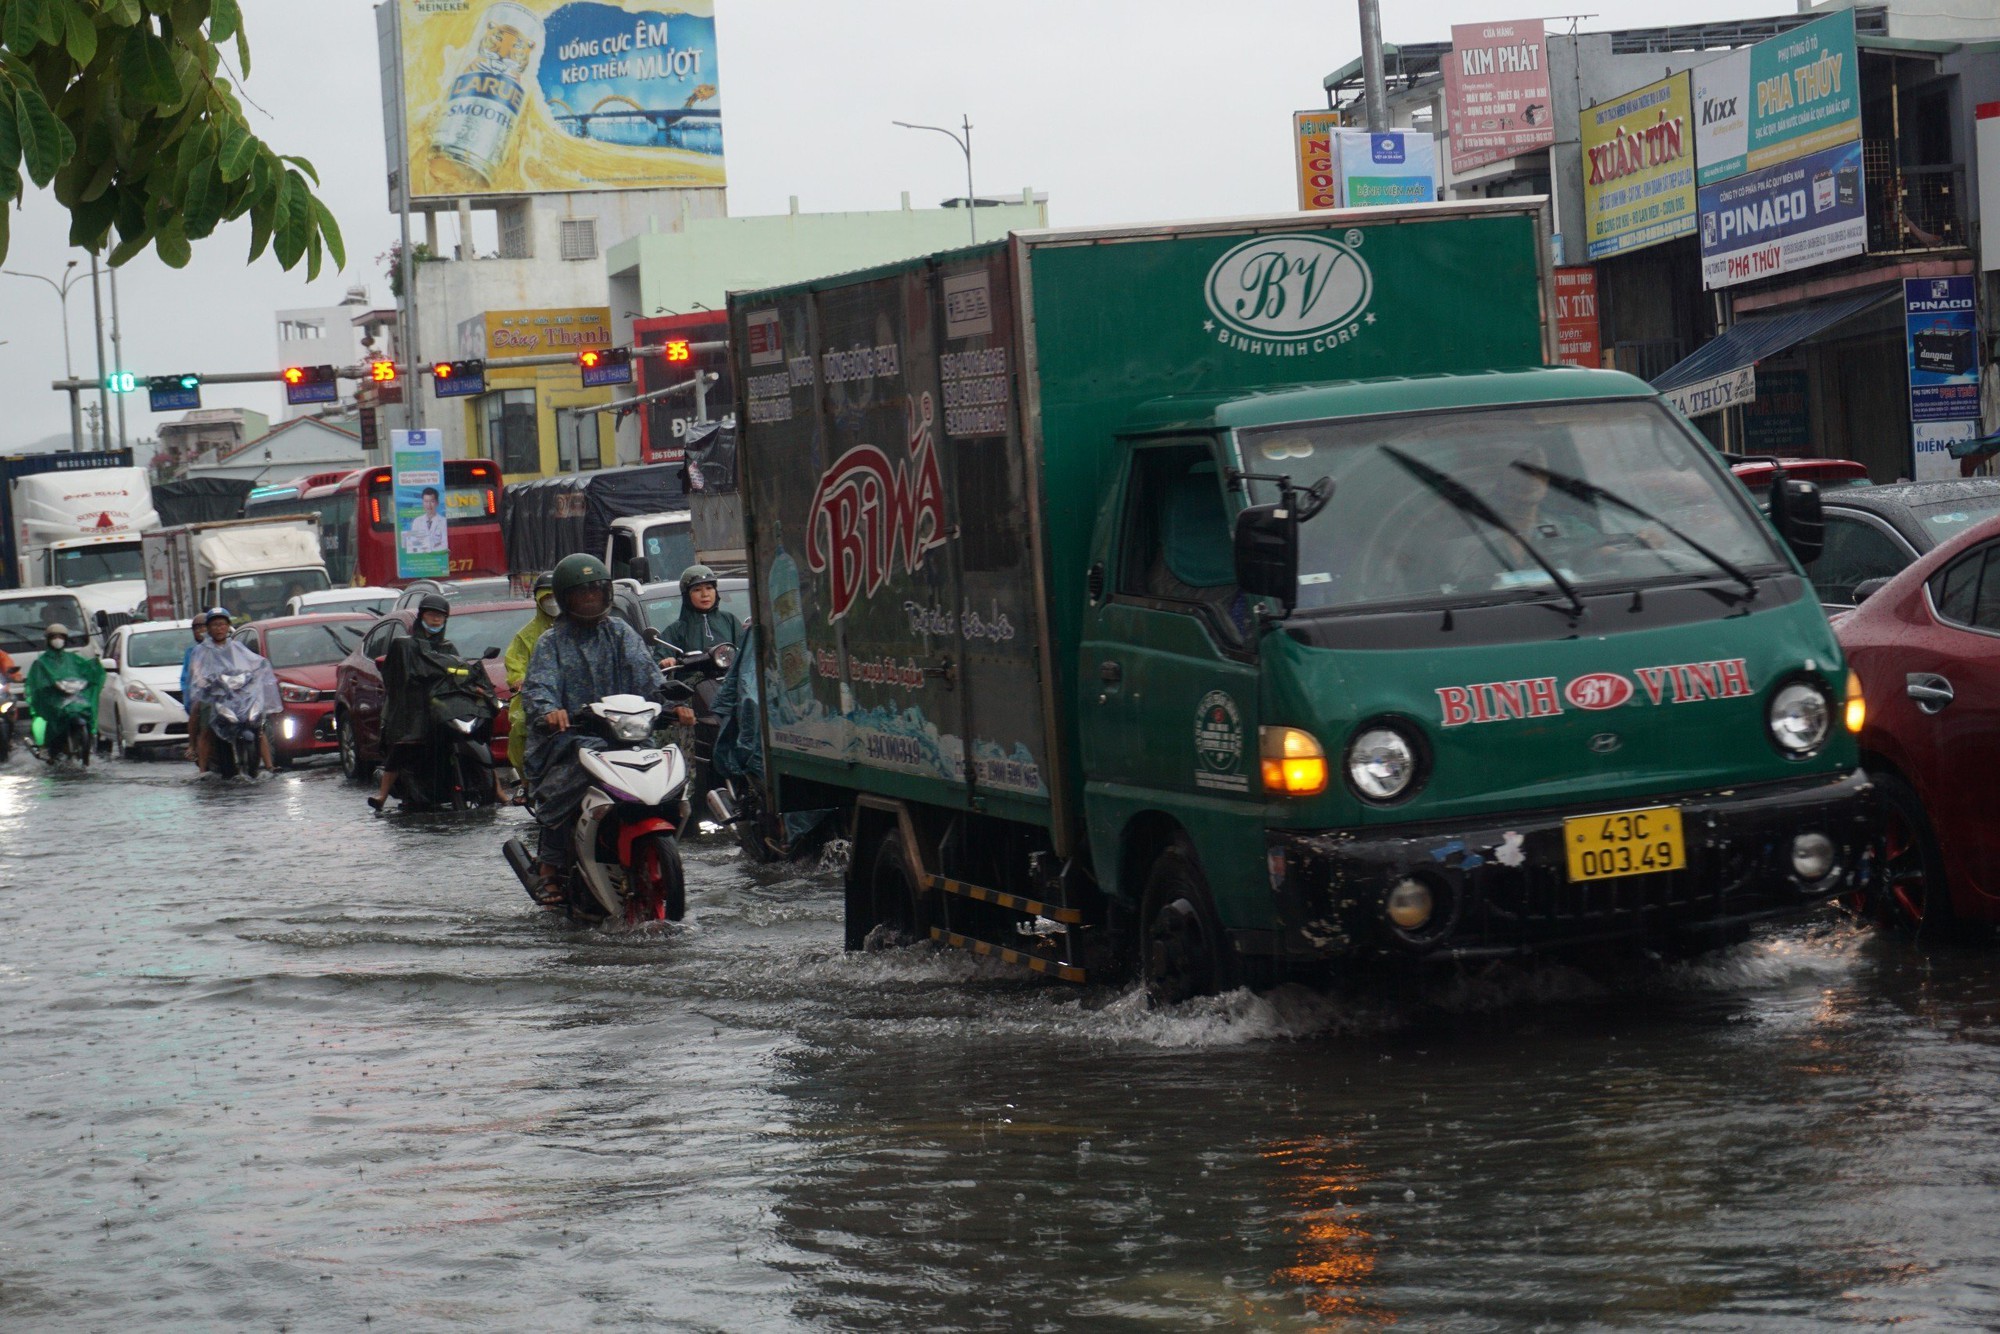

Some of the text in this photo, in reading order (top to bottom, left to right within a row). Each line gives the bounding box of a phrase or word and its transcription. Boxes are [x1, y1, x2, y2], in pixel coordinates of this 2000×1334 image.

[418, 2, 470, 12] HEINEKEN
[559, 20, 669, 61] UỐNG CỰC ÊM
[1496, 26, 1514, 37] HÀNG
[1810, 33, 1818, 50] TÔ
[561, 48, 703, 85] KÈO THÊM MƯỢT
[1462, 39, 1539, 76] KIM PHÁT
[452, 76, 525, 109] LARUE
[1757, 49, 1842, 119] PHA THÚY
[448, 104, 511, 129] SMOOTH
[1702, 96, 1738, 126] Kixx
[1589, 108, 1684, 186] XUÂN TÍN
[1357, 184, 1380, 197] BỆNH
[1384, 184, 1404, 196] VIỆN
[1719, 190, 1733, 203] CÔNG
[1733, 189, 1739, 200] TY
[1757, 180, 1766, 193] PIN
[1772, 176, 1782, 190] QUY
[1794, 169, 1805, 182] NAM
[1720, 189, 1807, 240] PINACO
[1728, 254, 1750, 279] PHA
[1752, 244, 1781, 274] THÚY
[1577, 272, 1593, 285] THÉP
[1572, 290, 1595, 318] TÍN
[1909, 299, 1972, 311] PINACO
[544, 326, 611, 348] Thạnh
[1218, 322, 1360, 357] BINHVINH CORP
[1559, 328, 1582, 341] uyên:
[667, 341, 689, 361] 35
[373, 361, 395, 381] 35
[1690, 380, 1733, 412] THÚY
[663, 449, 677, 459] TÔN
[1435, 677, 1564, 727] BINH
[1634, 658, 1753, 705] VINH
[1601, 814, 1650, 842] 43C
[1581, 842, 1673, 877] 003.49
